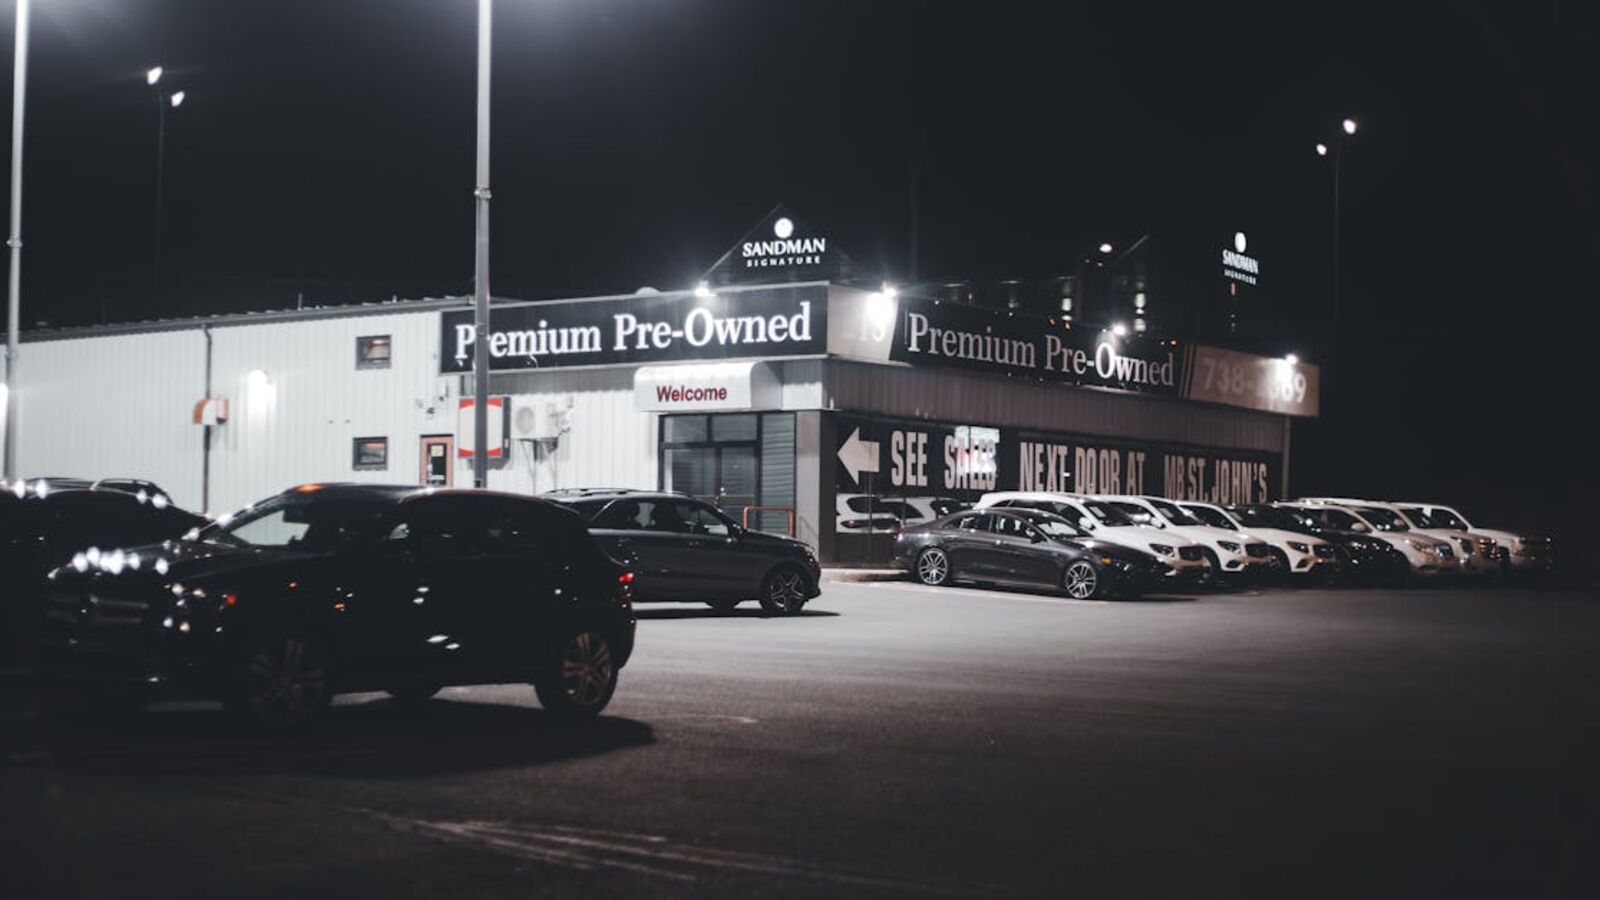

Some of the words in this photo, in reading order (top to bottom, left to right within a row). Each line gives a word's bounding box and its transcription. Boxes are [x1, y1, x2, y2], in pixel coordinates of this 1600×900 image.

[742, 238, 826, 257] SANDMAN
[746, 255, 821, 268] SIGNATURE
[1222, 249, 1259, 274] SANDMAN
[455, 319, 602, 358] Pemium
[613, 301, 812, 351] Pre-Owned
[908, 312, 1037, 369] Premium
[1044, 334, 1175, 387] Pre-Owned
[656, 385, 728, 403] Welcome
[1202, 357, 1307, 403] 738-9
[891, 430, 928, 487] SEE
[1019, 442, 1068, 493] NEXT
[1075, 446, 1120, 496] DOOR
[1126, 451, 1145, 496] AT
[1211, 459, 1268, 505] JOHN'S
